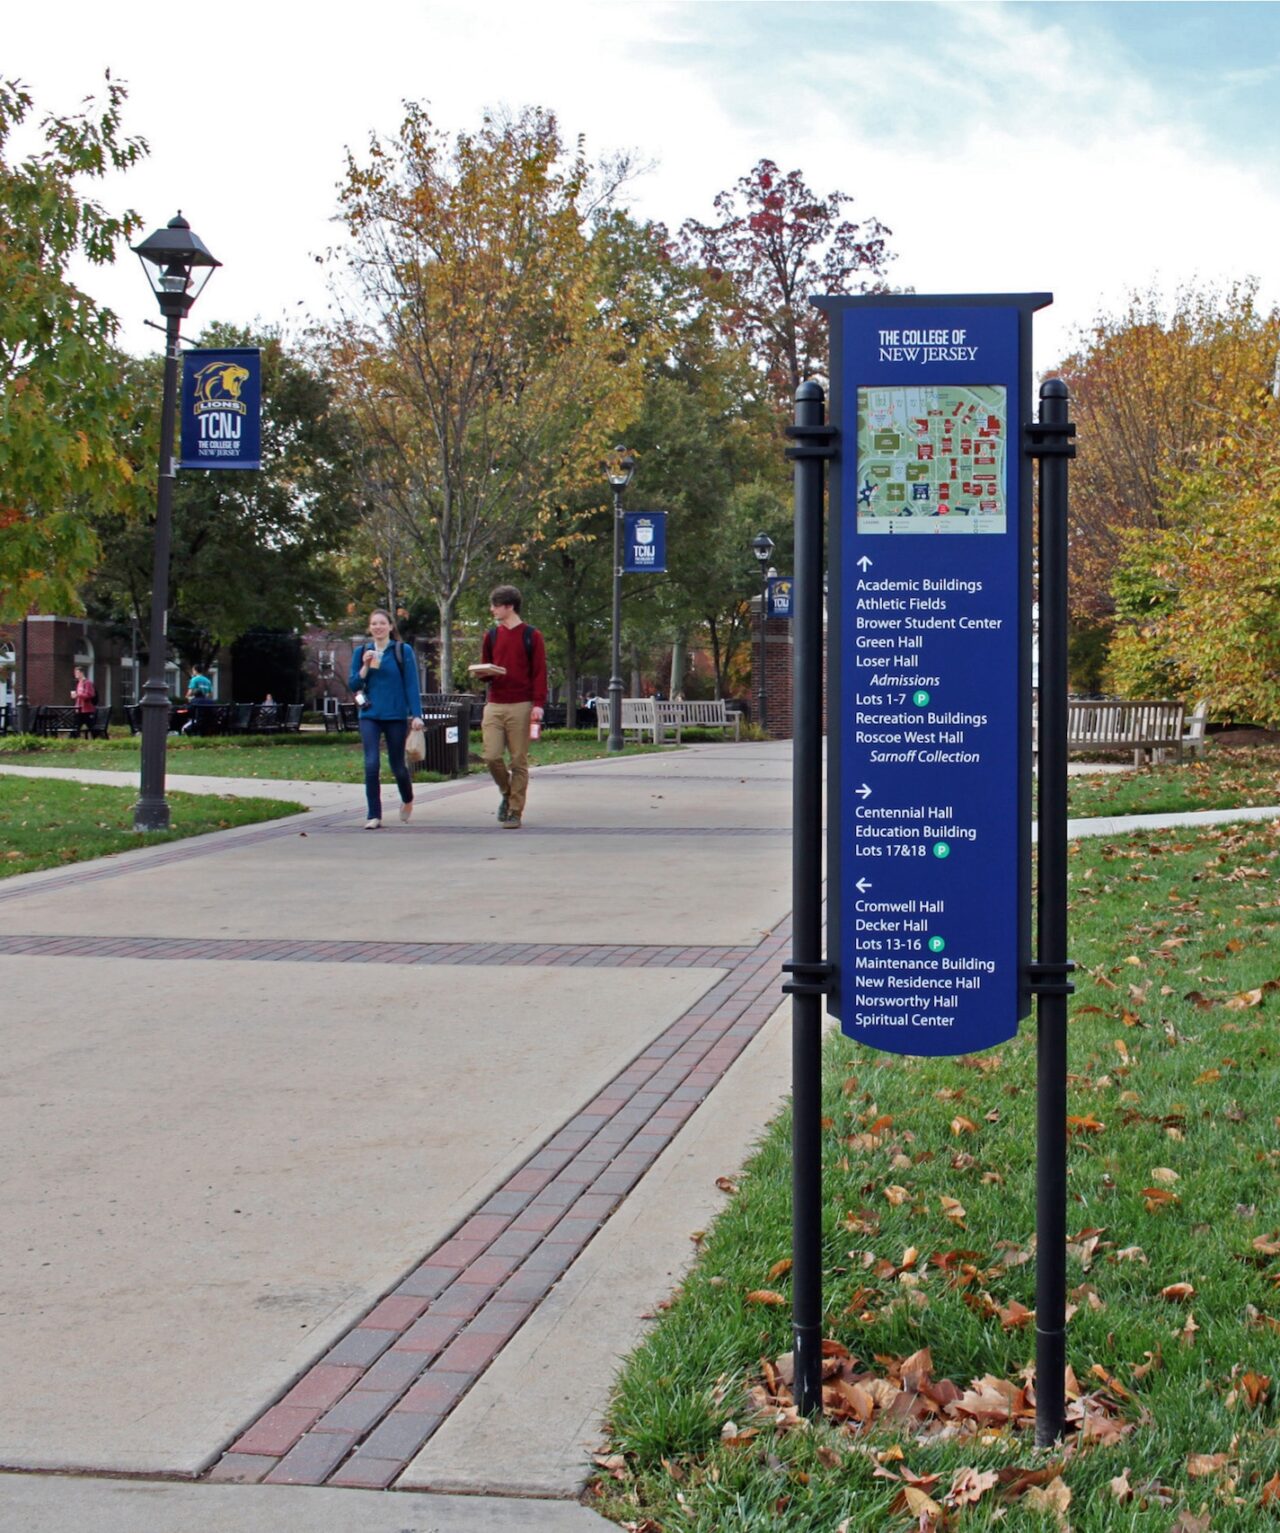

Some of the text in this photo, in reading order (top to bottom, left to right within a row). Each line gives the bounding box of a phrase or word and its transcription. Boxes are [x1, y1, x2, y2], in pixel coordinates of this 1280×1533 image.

[878, 329, 967, 346] THE COLLEGE OF
[878, 346, 979, 365] NEW JERSEY
[200, 401, 241, 410] LIONS
[198, 412, 242, 439] TCNJ
[198, 440, 241, 449] THE COLLEGE OF
[216, 449, 241, 457] JERSEY
[856, 578, 983, 595] Academic Buildings
[856, 597, 947, 611] Athletic Fields
[856, 616, 1003, 630] Brower Student Center
[855, 635, 923, 649] Green Hall
[856, 654, 919, 668] Loser Hall
[869, 674, 941, 688] Admissions
[856, 693, 883, 706] Lots
[886, 693, 907, 706] 1-7
[855, 711, 988, 728] Recreation Buildings
[855, 730, 964, 744] Roscoe West Hall
[869, 749, 980, 763] Sarnoff Collection
[855, 805, 953, 819] Centennial Hall
[855, 824, 977, 841] Education Building
[855, 844, 883, 857] Lots
[886, 844, 927, 857] 17&18
[855, 899, 944, 913] Cromwell Hall
[855, 918, 928, 932] Decker Hall
[855, 937, 883, 951] Lots
[886, 938, 922, 951] 13-16
[855, 956, 996, 974] Maintenance Building
[855, 975, 981, 989] New Residence Hall
[855, 994, 958, 1010] Norsworthy Hall
[855, 1013, 955, 1029] Spiritual Center
